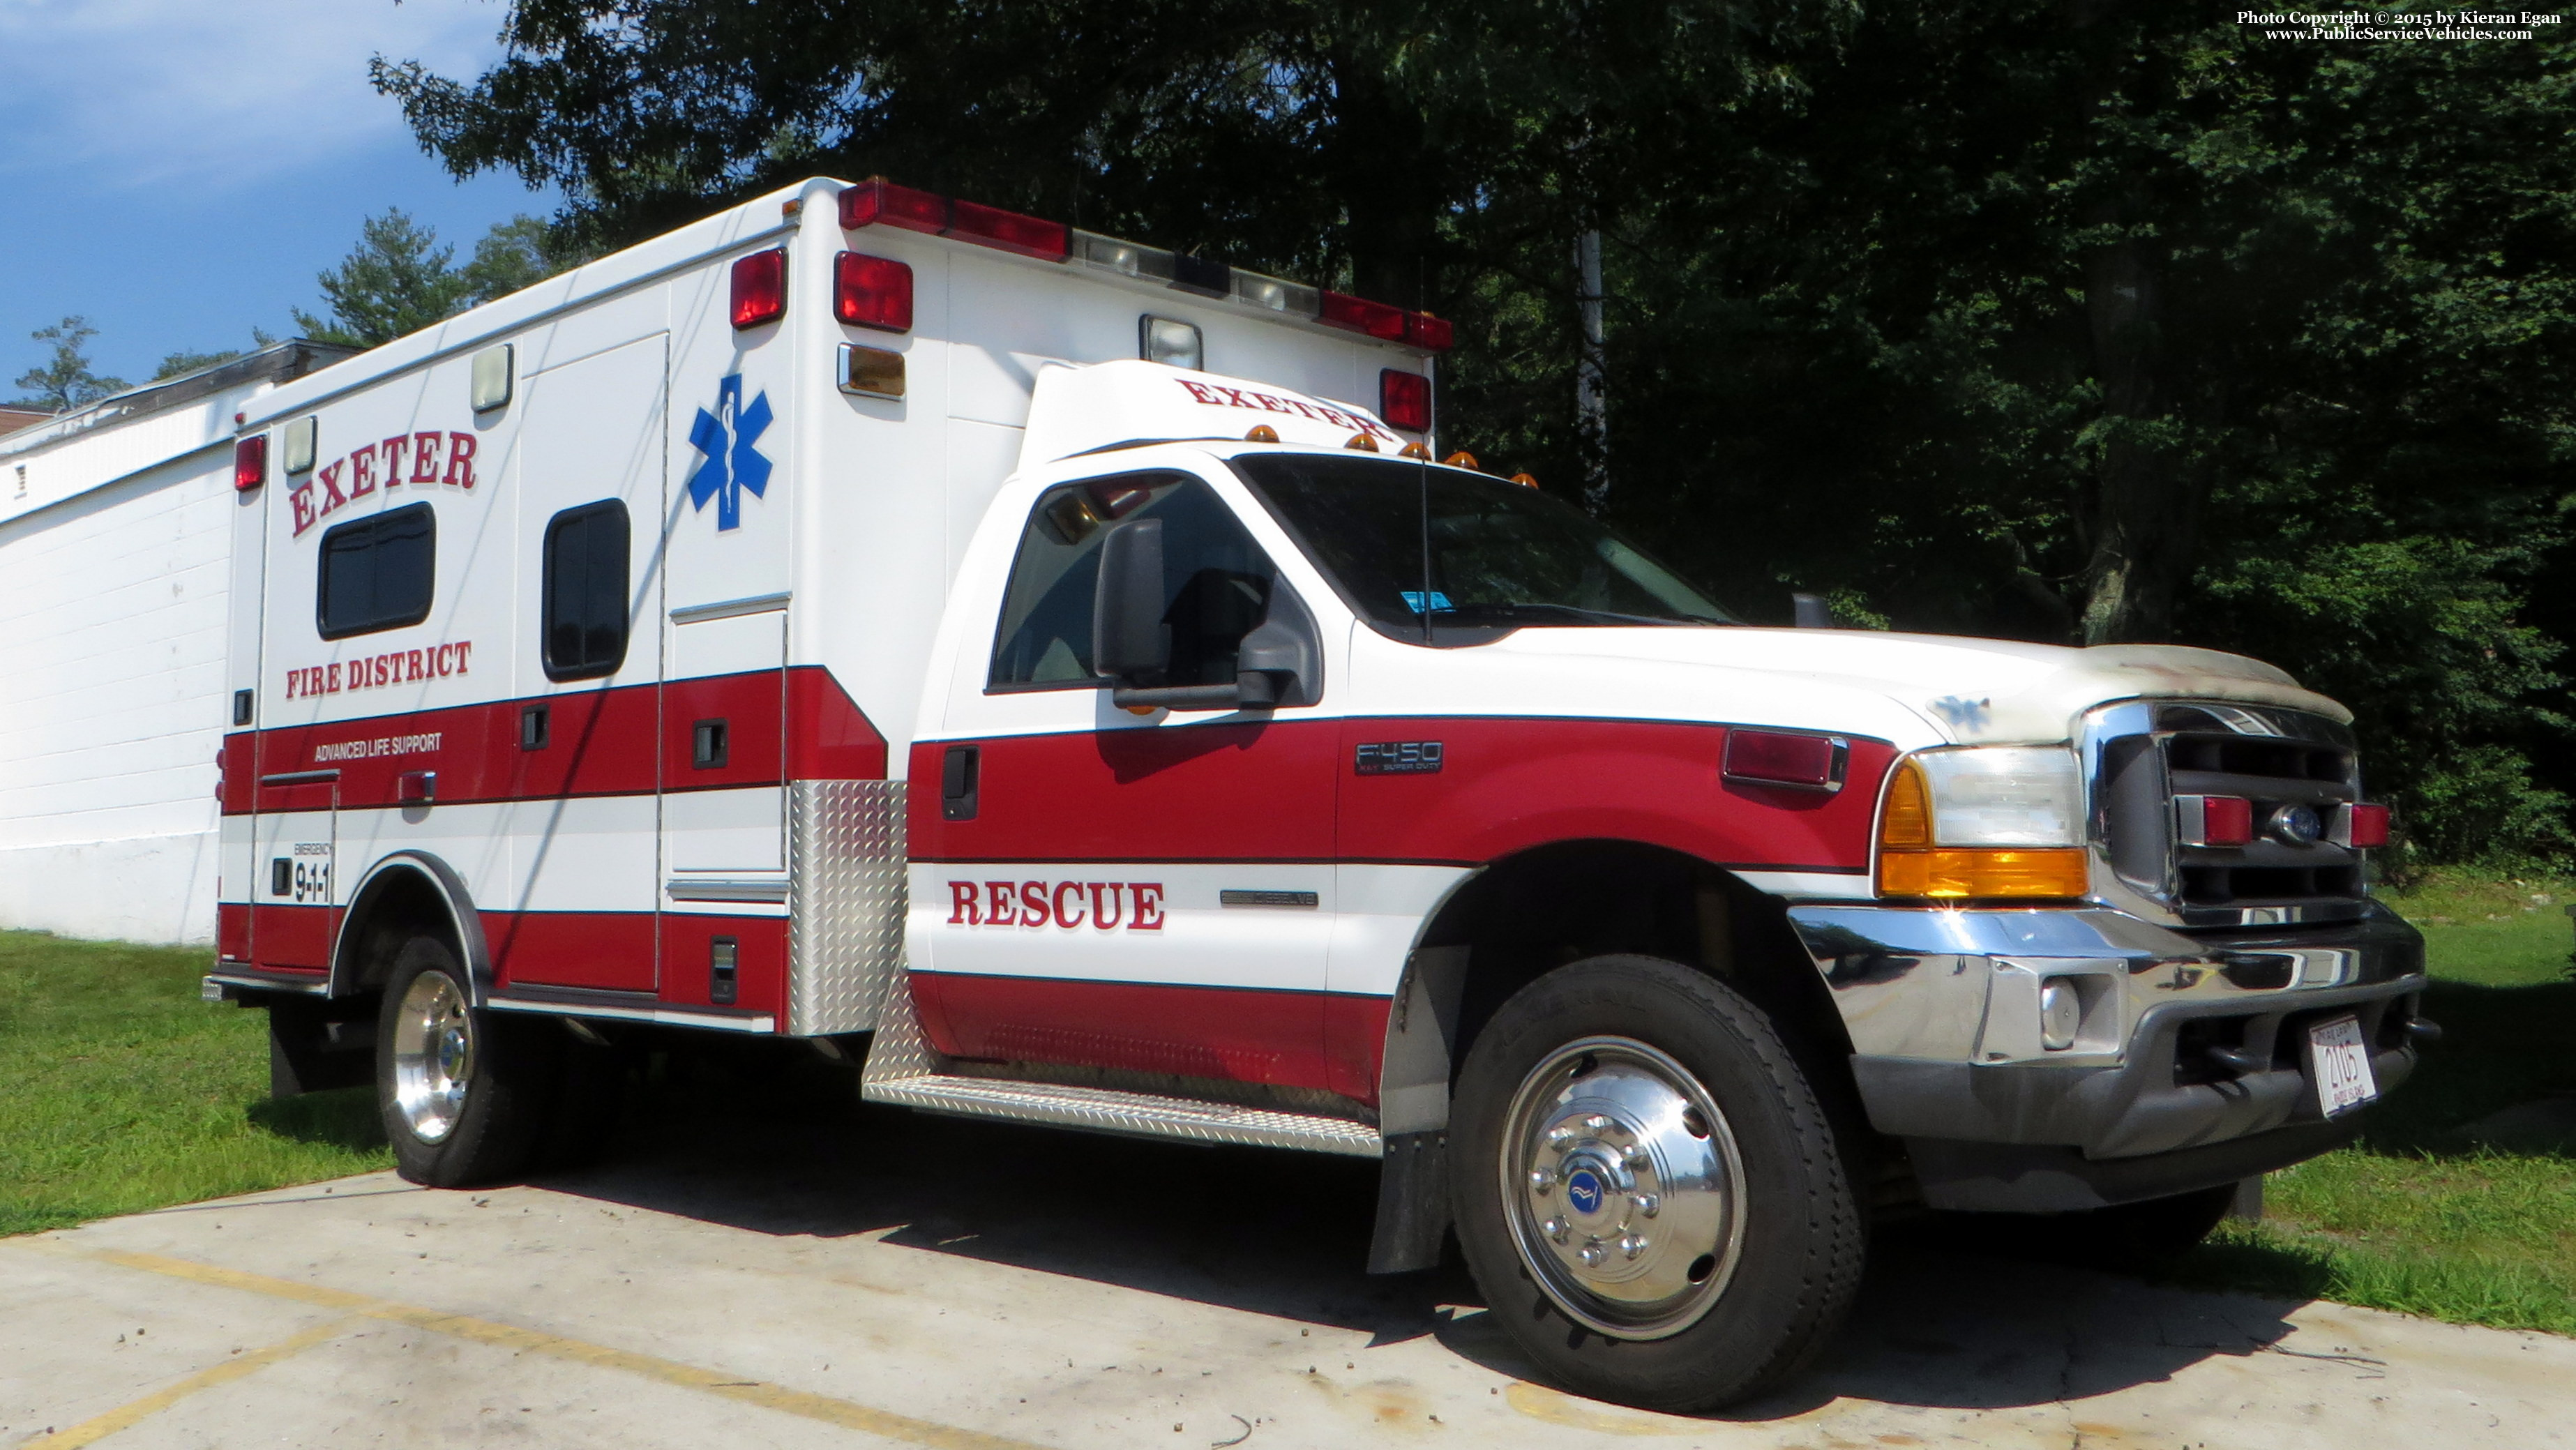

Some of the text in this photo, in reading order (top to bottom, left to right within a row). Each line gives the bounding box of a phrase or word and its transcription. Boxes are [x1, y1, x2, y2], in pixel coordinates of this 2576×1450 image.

[1173, 378, 1395, 444] EXETER
[289, 431, 478, 538] EXETER
[286, 640, 472, 700] FIRE DISTRICT
[315, 732, 442, 762] ADVANCED LIFE SUPPORT
[1356, 742, 1443, 764] F-450
[296, 862, 329, 903] 9-1-1
[947, 880, 1166, 932] RESCUE
[2324, 1040, 2358, 1088] 2105
